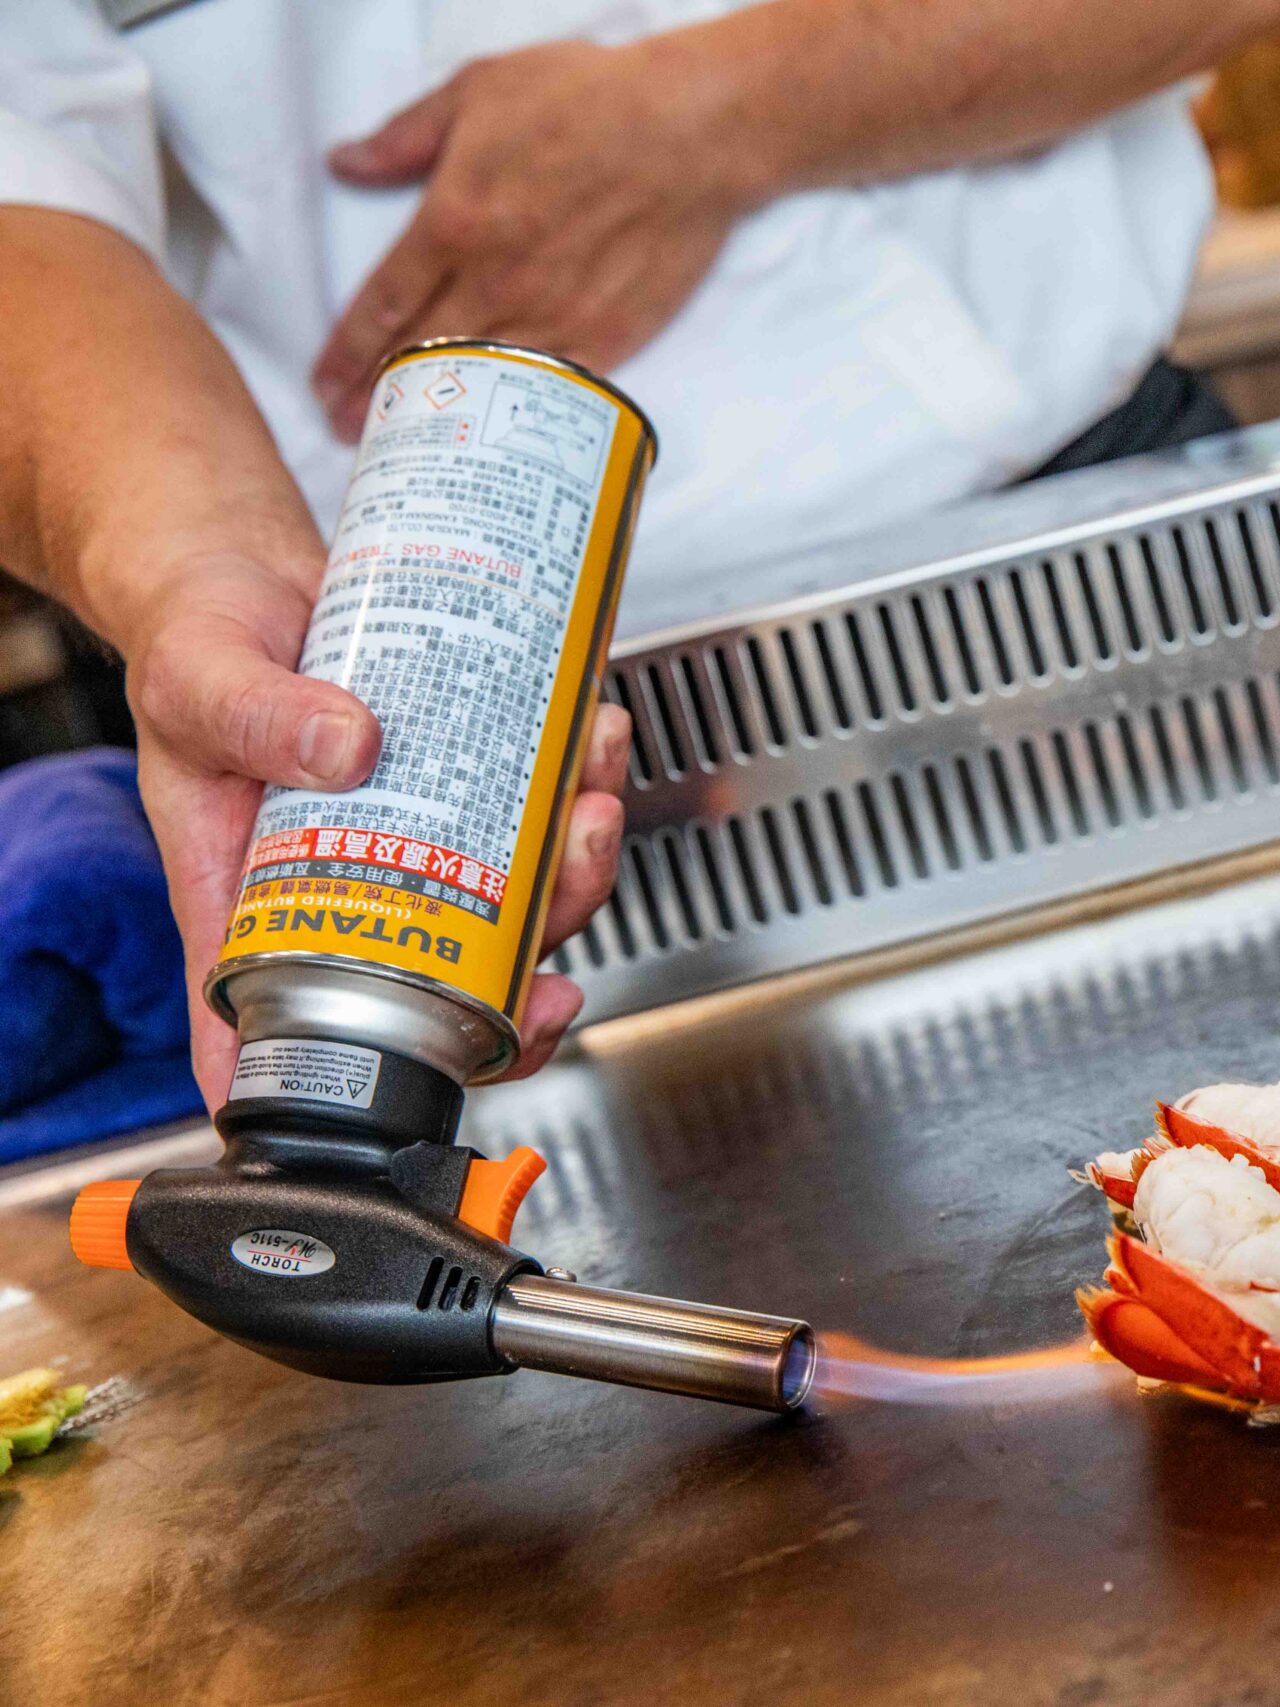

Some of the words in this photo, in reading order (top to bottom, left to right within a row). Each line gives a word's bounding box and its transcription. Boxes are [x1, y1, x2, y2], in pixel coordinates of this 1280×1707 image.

[400, 543, 441, 556] GAS
[446, 546, 522, 578] BUTANE
[382, 725, 522, 778] 嚴禁在高溫場所附近使
[379, 751, 517, 804] 換裝瓦斯罐時，請遠離
[313, 830, 506, 903] 注意火源及高溫
[300, 896, 412, 920] (LIQUEFIED
[264, 909, 462, 965] BUTANE
[279, 1079, 343, 1096] CAUTION
[251, 1254, 302, 1272] TORCH
